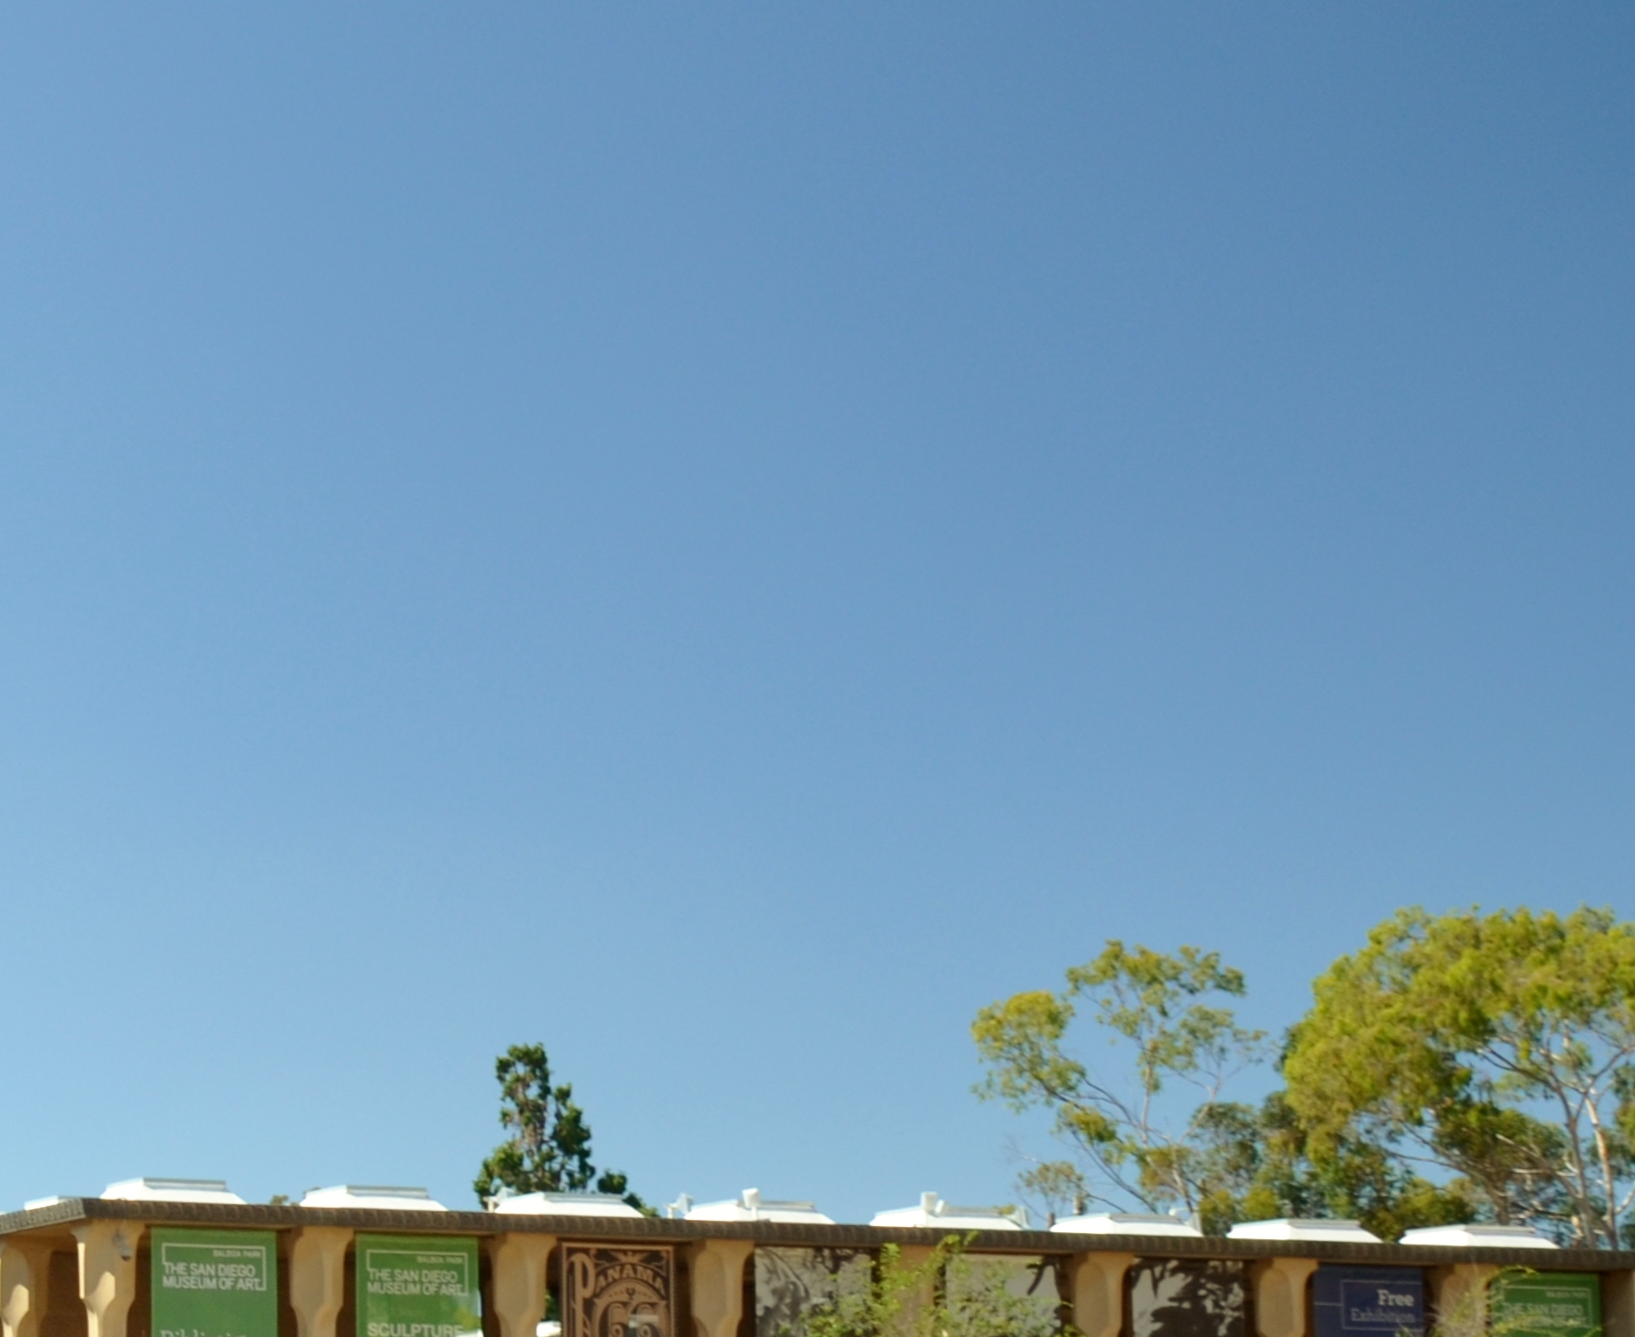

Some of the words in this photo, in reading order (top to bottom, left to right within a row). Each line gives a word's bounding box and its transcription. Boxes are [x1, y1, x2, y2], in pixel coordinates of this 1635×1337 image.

[163, 1262, 188, 1275] THE
[189, 1263, 215, 1276] SAN
[217, 1264, 256, 1278] DIEGO
[367, 1268, 392, 1281] THE
[393, 1269, 419, 1282] SAN
[421, 1270, 458, 1283] DIEGO
[162, 1276, 217, 1289] MUSEUM
[218, 1278, 235, 1290] OF
[236, 1278, 261, 1291] ART
[367, 1281, 421, 1294] MUSEUM
[422, 1283, 439, 1295] OF
[440, 1284, 464, 1296] ART
[1377, 1288, 1415, 1307] Free
[1350, 1306, 1415, 1323] Exhibition
